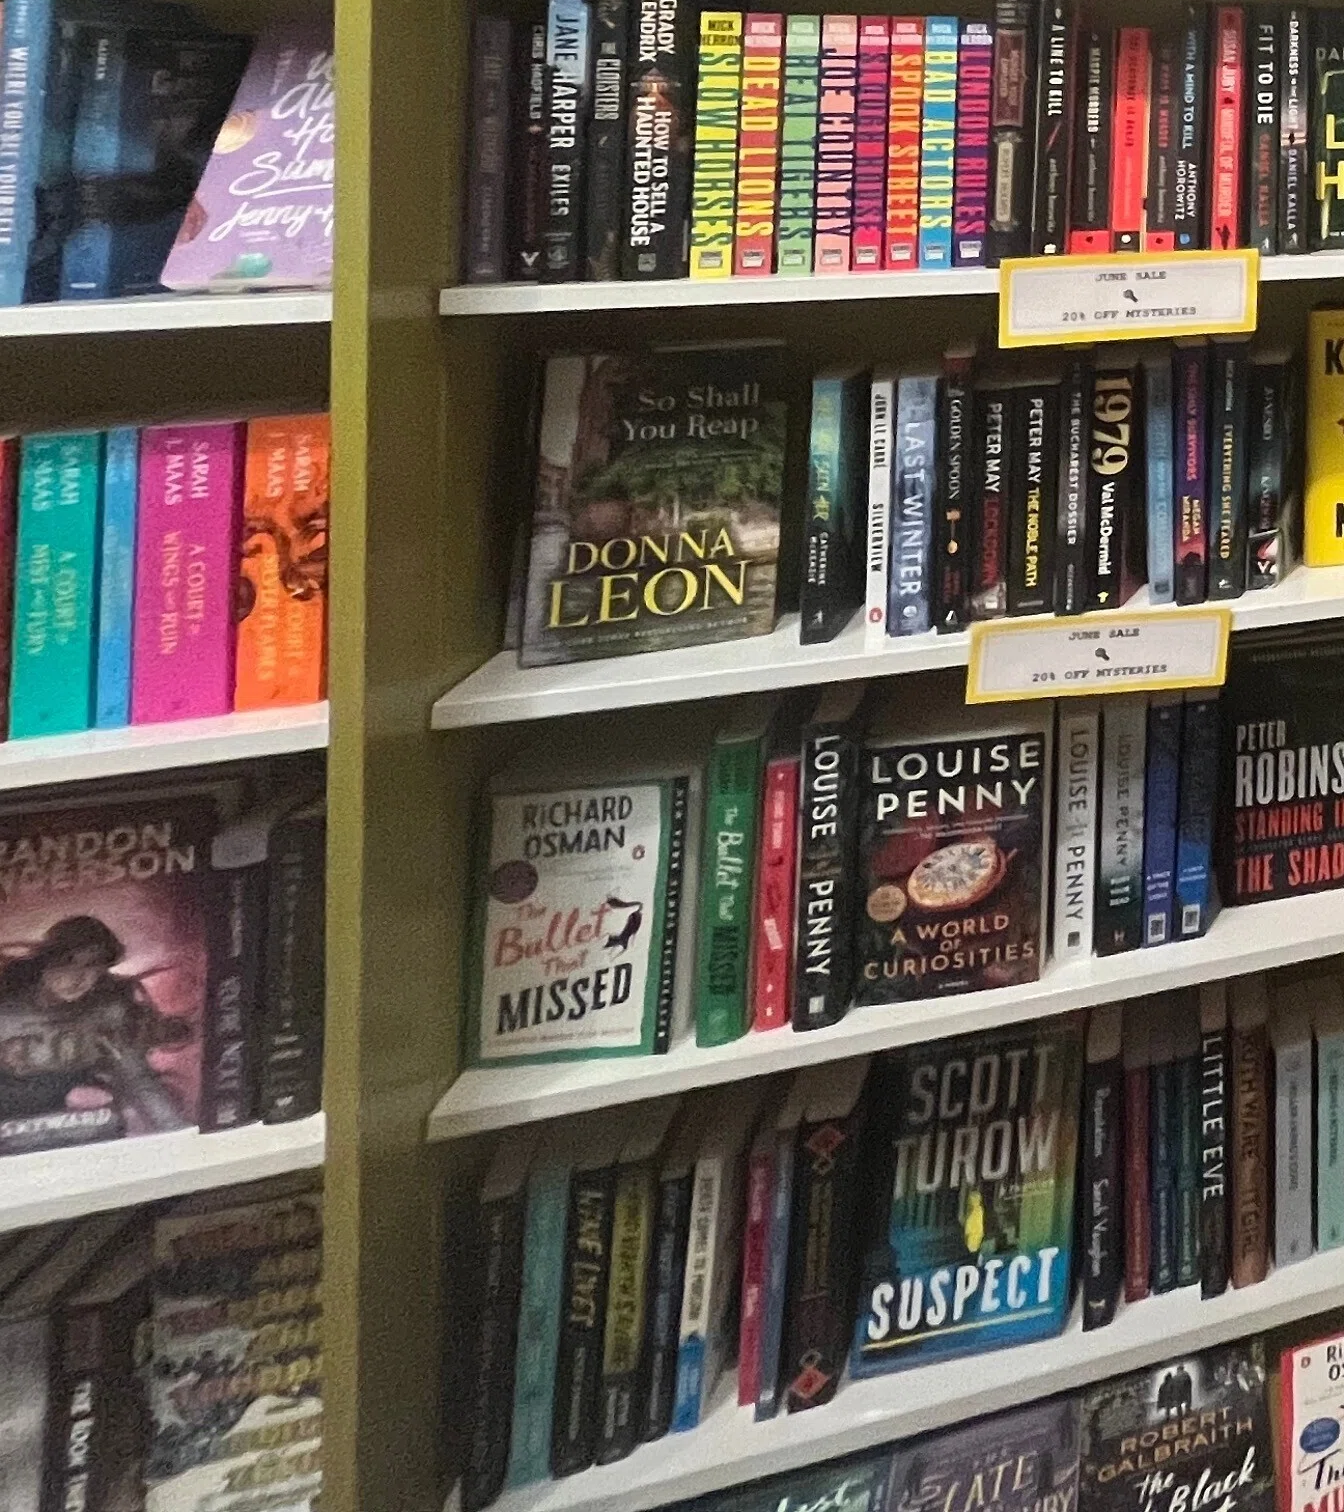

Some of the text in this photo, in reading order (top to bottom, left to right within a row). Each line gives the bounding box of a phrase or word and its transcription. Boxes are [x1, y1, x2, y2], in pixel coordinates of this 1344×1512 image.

[548, 14, 579, 217] JANE HARPER EXILES
[630, 96, 657, 248] HAUNTED HOUSE
[649, 111, 672, 234] HOW TO SELL A
[164, 454, 184, 506] MAAS
[190, 441, 210, 499] SARAH
[567, 527, 736, 576] DONNA
[546, 559, 750, 631] LEON
[1236, 720, 1287, 752] PETER
[871, 741, 1042, 784] LOUISE
[523, 795, 633, 827] RICHARD
[876, 779, 1037, 821] PENNY
[1234, 800, 1322, 840] STANDING
[524, 825, 625, 860] OSMAN
[1236, 857, 1275, 893] THE
[891, 914, 1010, 944] A WORLD
[940, 936, 961, 952] OF
[864, 943, 1036, 981] CURIOSITIES
[497, 962, 633, 1036] MISSED
[909, 1045, 1055, 1126] SCOTT
[1202, 1034, 1225, 1203] LITTLE EVE
[895, 1113, 1058, 1197] TUROW
[867, 1248, 1060, 1342] SUSPECT
